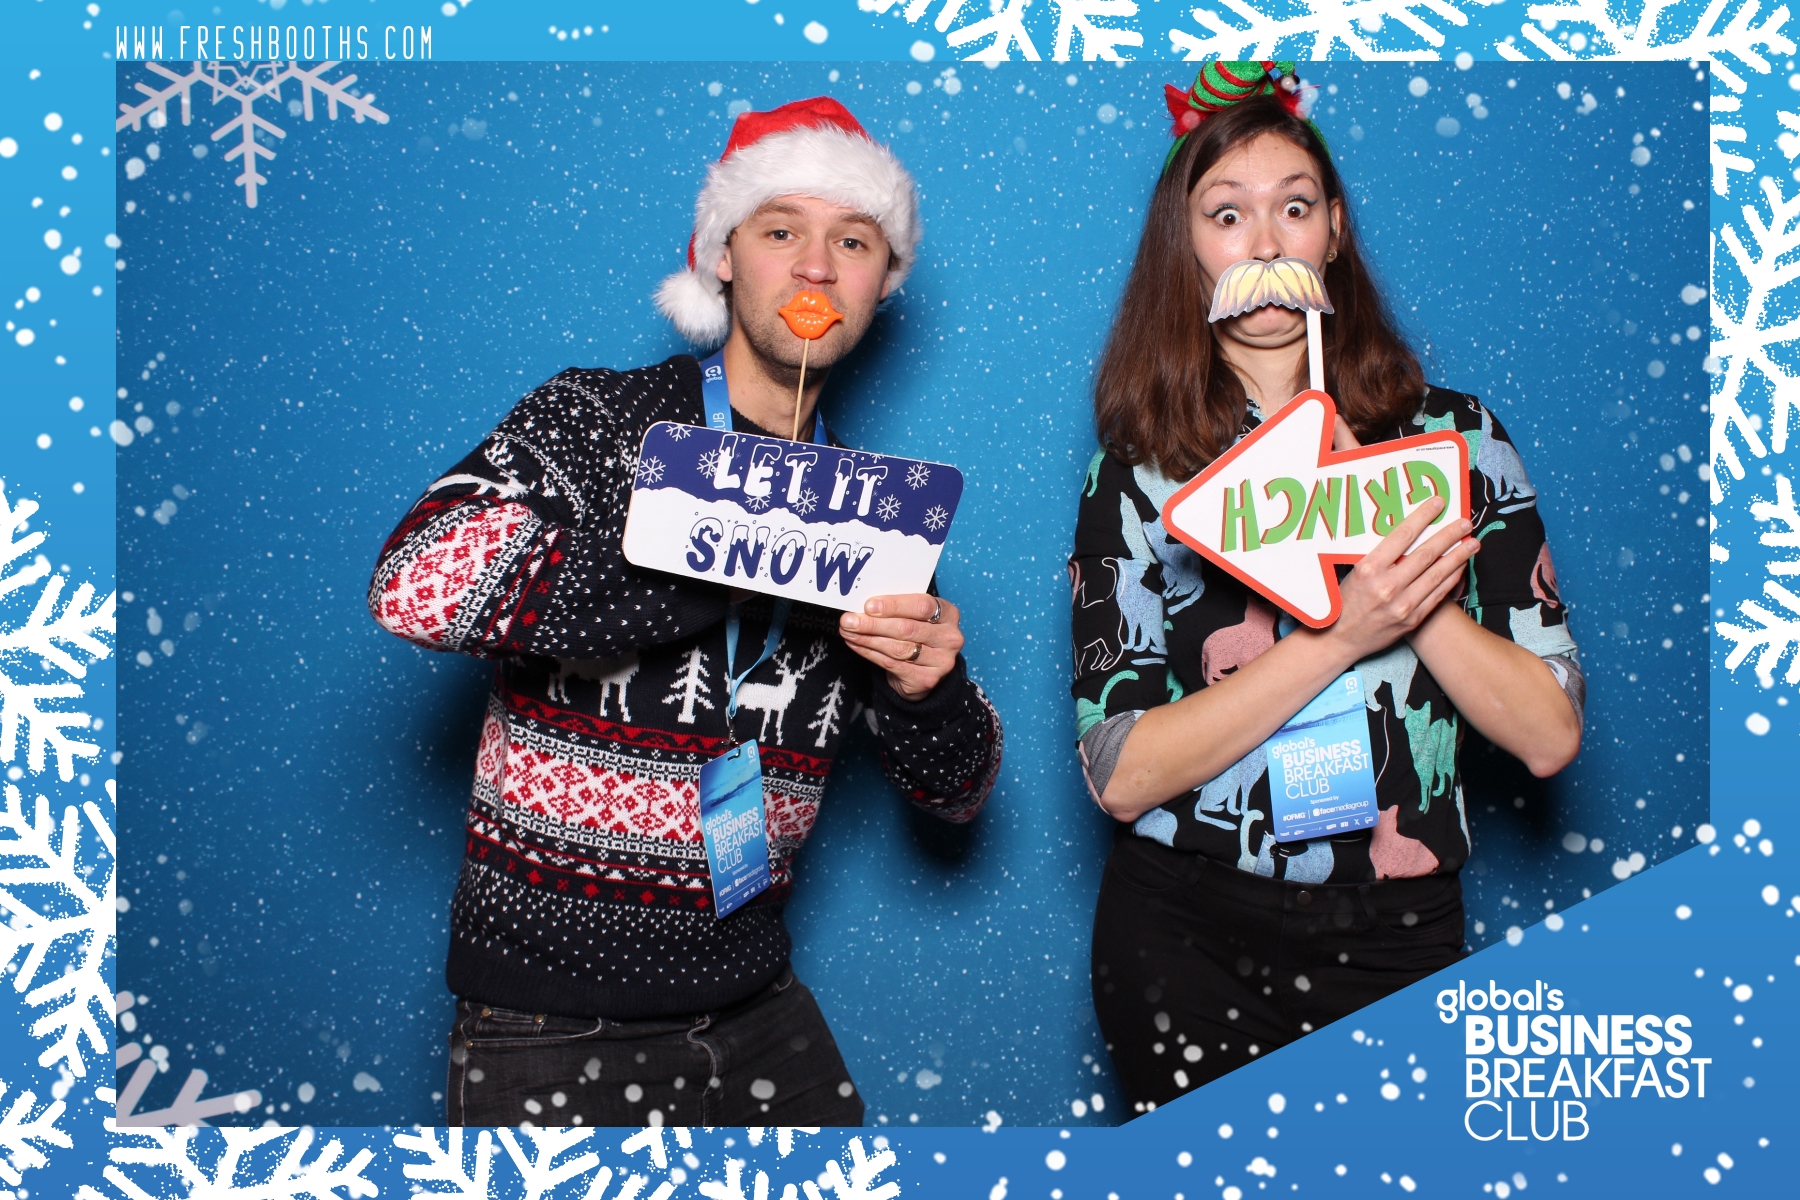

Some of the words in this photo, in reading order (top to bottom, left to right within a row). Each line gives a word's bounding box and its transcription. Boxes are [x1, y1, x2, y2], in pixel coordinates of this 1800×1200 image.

[713, 433, 818, 503] LET
[829, 458, 888, 516] IT
[1220, 460, 1451, 553] GRINCH
[686, 516, 874, 596] SNOW
[1272, 737, 1316, 760] global's
[1282, 739, 1362, 769] BUSINESS
[1284, 753, 1369, 784] BREAKFAST
[1285, 777, 1330, 800] CLUB
[705, 809, 732, 835] global's
[713, 807, 759, 844] BUSINESS
[715, 819, 763, 859] BREAKFAST
[717, 848, 743, 873] CLUB
